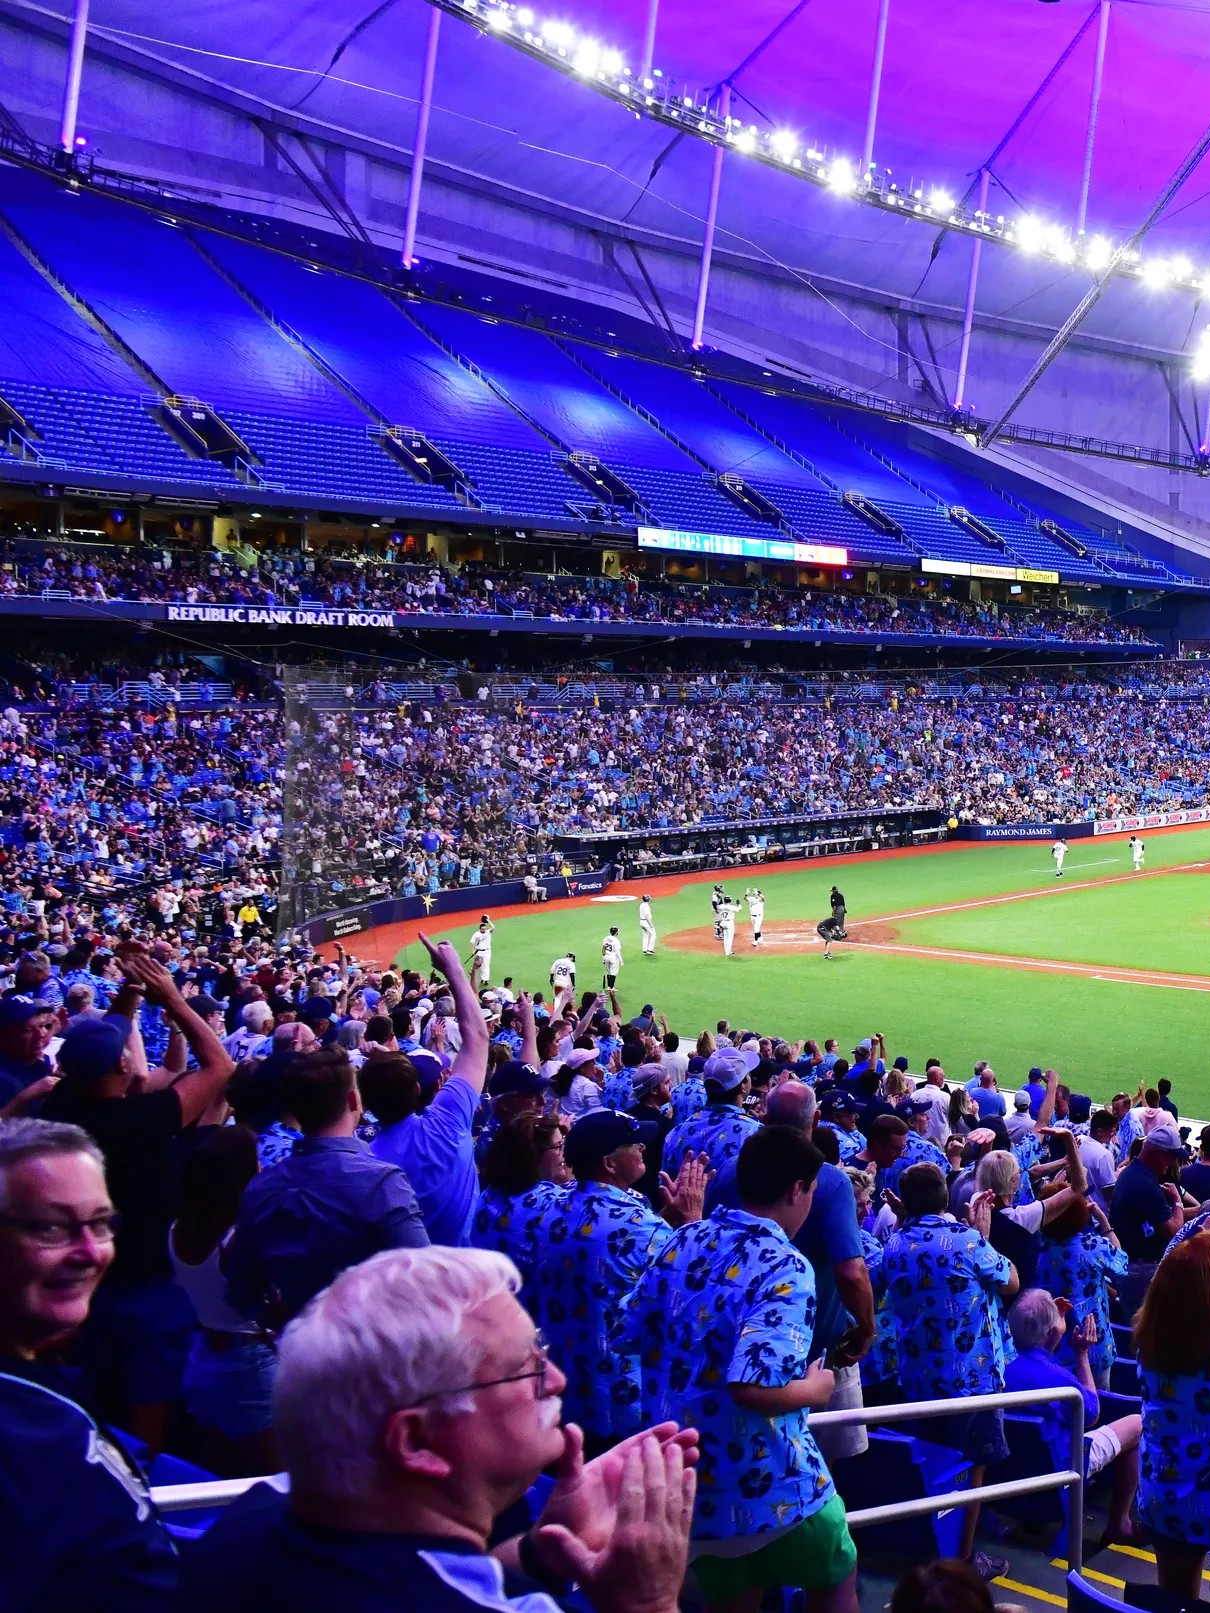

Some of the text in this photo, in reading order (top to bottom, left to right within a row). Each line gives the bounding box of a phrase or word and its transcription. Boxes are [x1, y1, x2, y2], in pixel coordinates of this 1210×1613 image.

[1022, 570, 1054, 583] Weichert
[168, 606, 394, 627] REPUBLIC BANK DRAFT ROOM
[985, 828, 1052, 836] RAYMOND JAMES
[578, 882, 602, 890] Fanatics
[556, 966, 568, 976] 28
